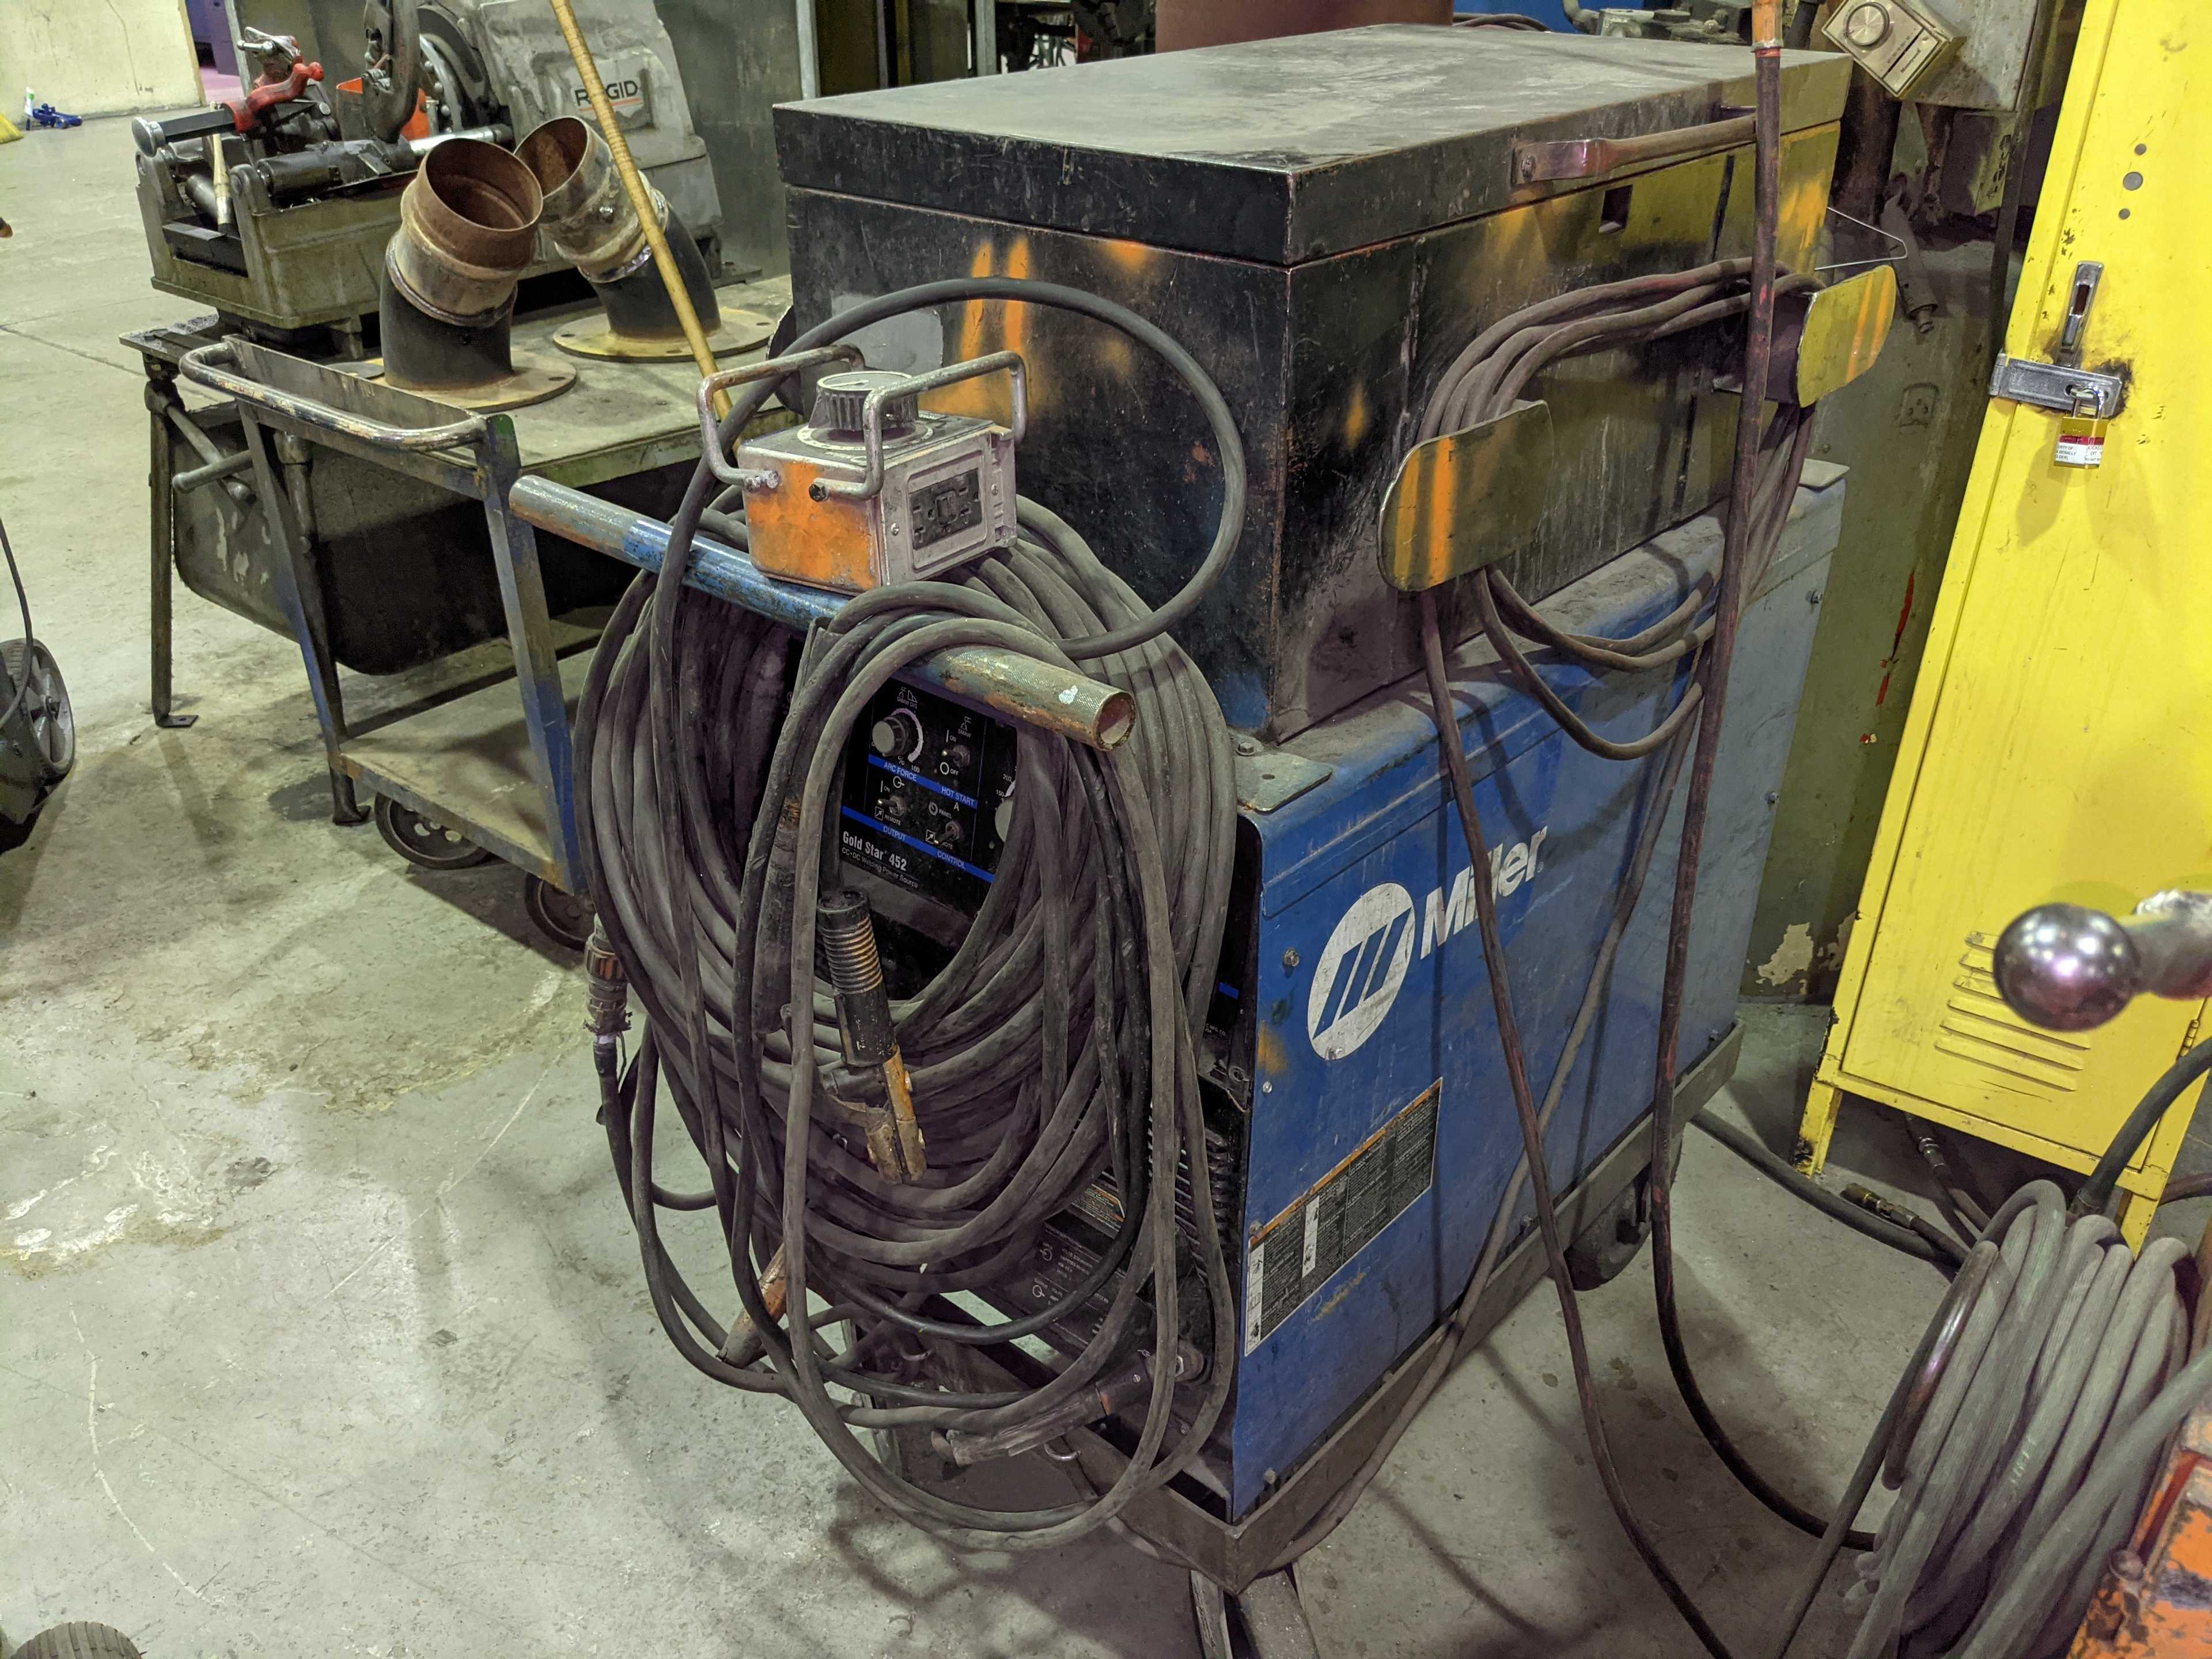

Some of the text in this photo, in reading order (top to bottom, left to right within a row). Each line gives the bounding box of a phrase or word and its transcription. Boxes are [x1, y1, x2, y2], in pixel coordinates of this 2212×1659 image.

[575, 80, 638, 107] RGID
[884, 762, 917, 782] ARC FORCE
[911, 765, 920, 773] 100
[950, 767, 959, 776] OFF
[941, 786, 975, 806] HOT START
[884, 814, 902, 826] REMOTE
[939, 809, 953, 819] PANEL
[883, 825, 907, 841] OUTPUT
[843, 831, 907, 871] Gold Star 452
[937, 851, 966, 869] CONTROL
[882, 866, 899, 880] Power
[900, 875, 919, 889] Source
[1421, 825, 1548, 960] Miler
